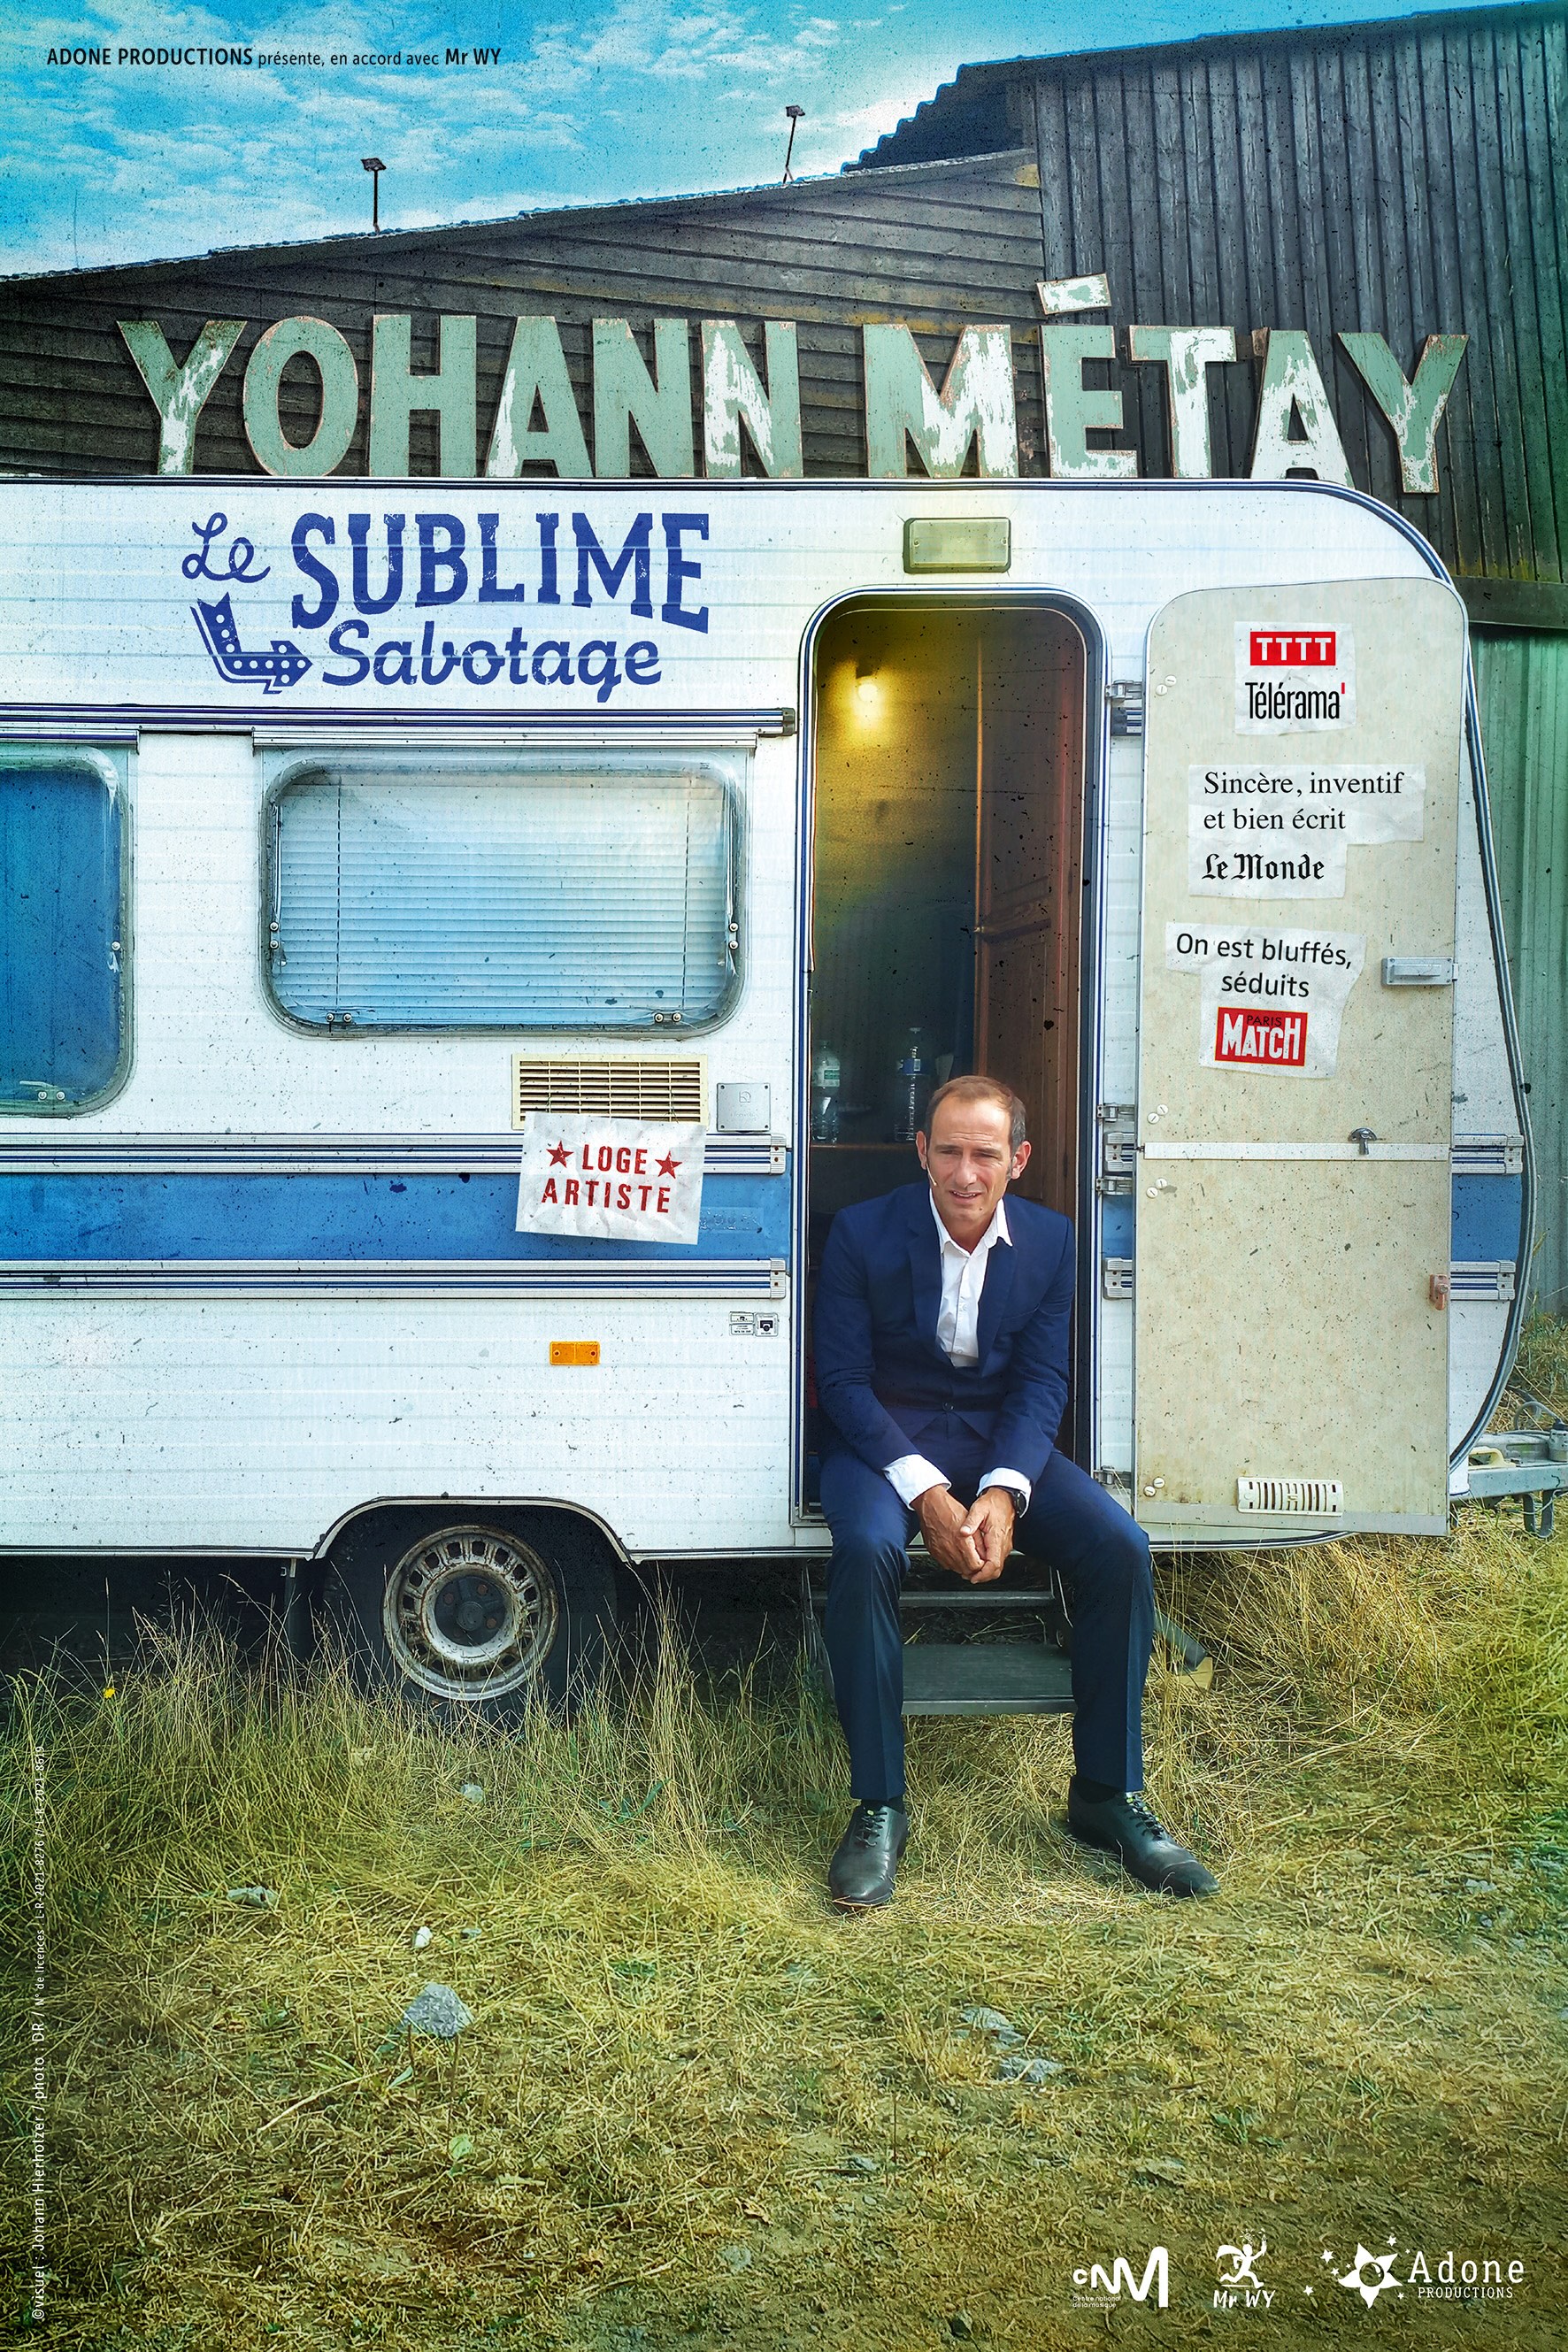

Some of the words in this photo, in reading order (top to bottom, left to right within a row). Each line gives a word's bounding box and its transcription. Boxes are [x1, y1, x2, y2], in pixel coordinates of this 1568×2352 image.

[118, 315, 803, 480] YOHANN
[864, 273, 1469, 494] MÉTAY
[181, 511, 271, 582] Le
[291, 512, 710, 634] SUBLIME
[322, 619, 663, 703] Sabotage
[1256, 636, 1333, 662] TTTT
[1203, 771, 1303, 798] Sincère,
[1309, 771, 1405, 796] inventif
[1203, 811, 1226, 830] et
[1232, 807, 1285, 830] bien
[1291, 807, 1347, 830] écrit
[1202, 853, 1229, 880] Le
[1233, 852, 1326, 881] Monde
[1175, 932, 1209, 957] On
[1216, 936, 1254, 959] est
[1262, 932, 1353, 970] bluffés,
[1220, 971, 1311, 998] séduits
[1221, 1013, 1302, 1060] MATCH
[1246, 1015, 1282, 1026] PARIS
[580, 1144, 649, 1175] LOGE
[542, 1178, 672, 1213] ARTISTE
